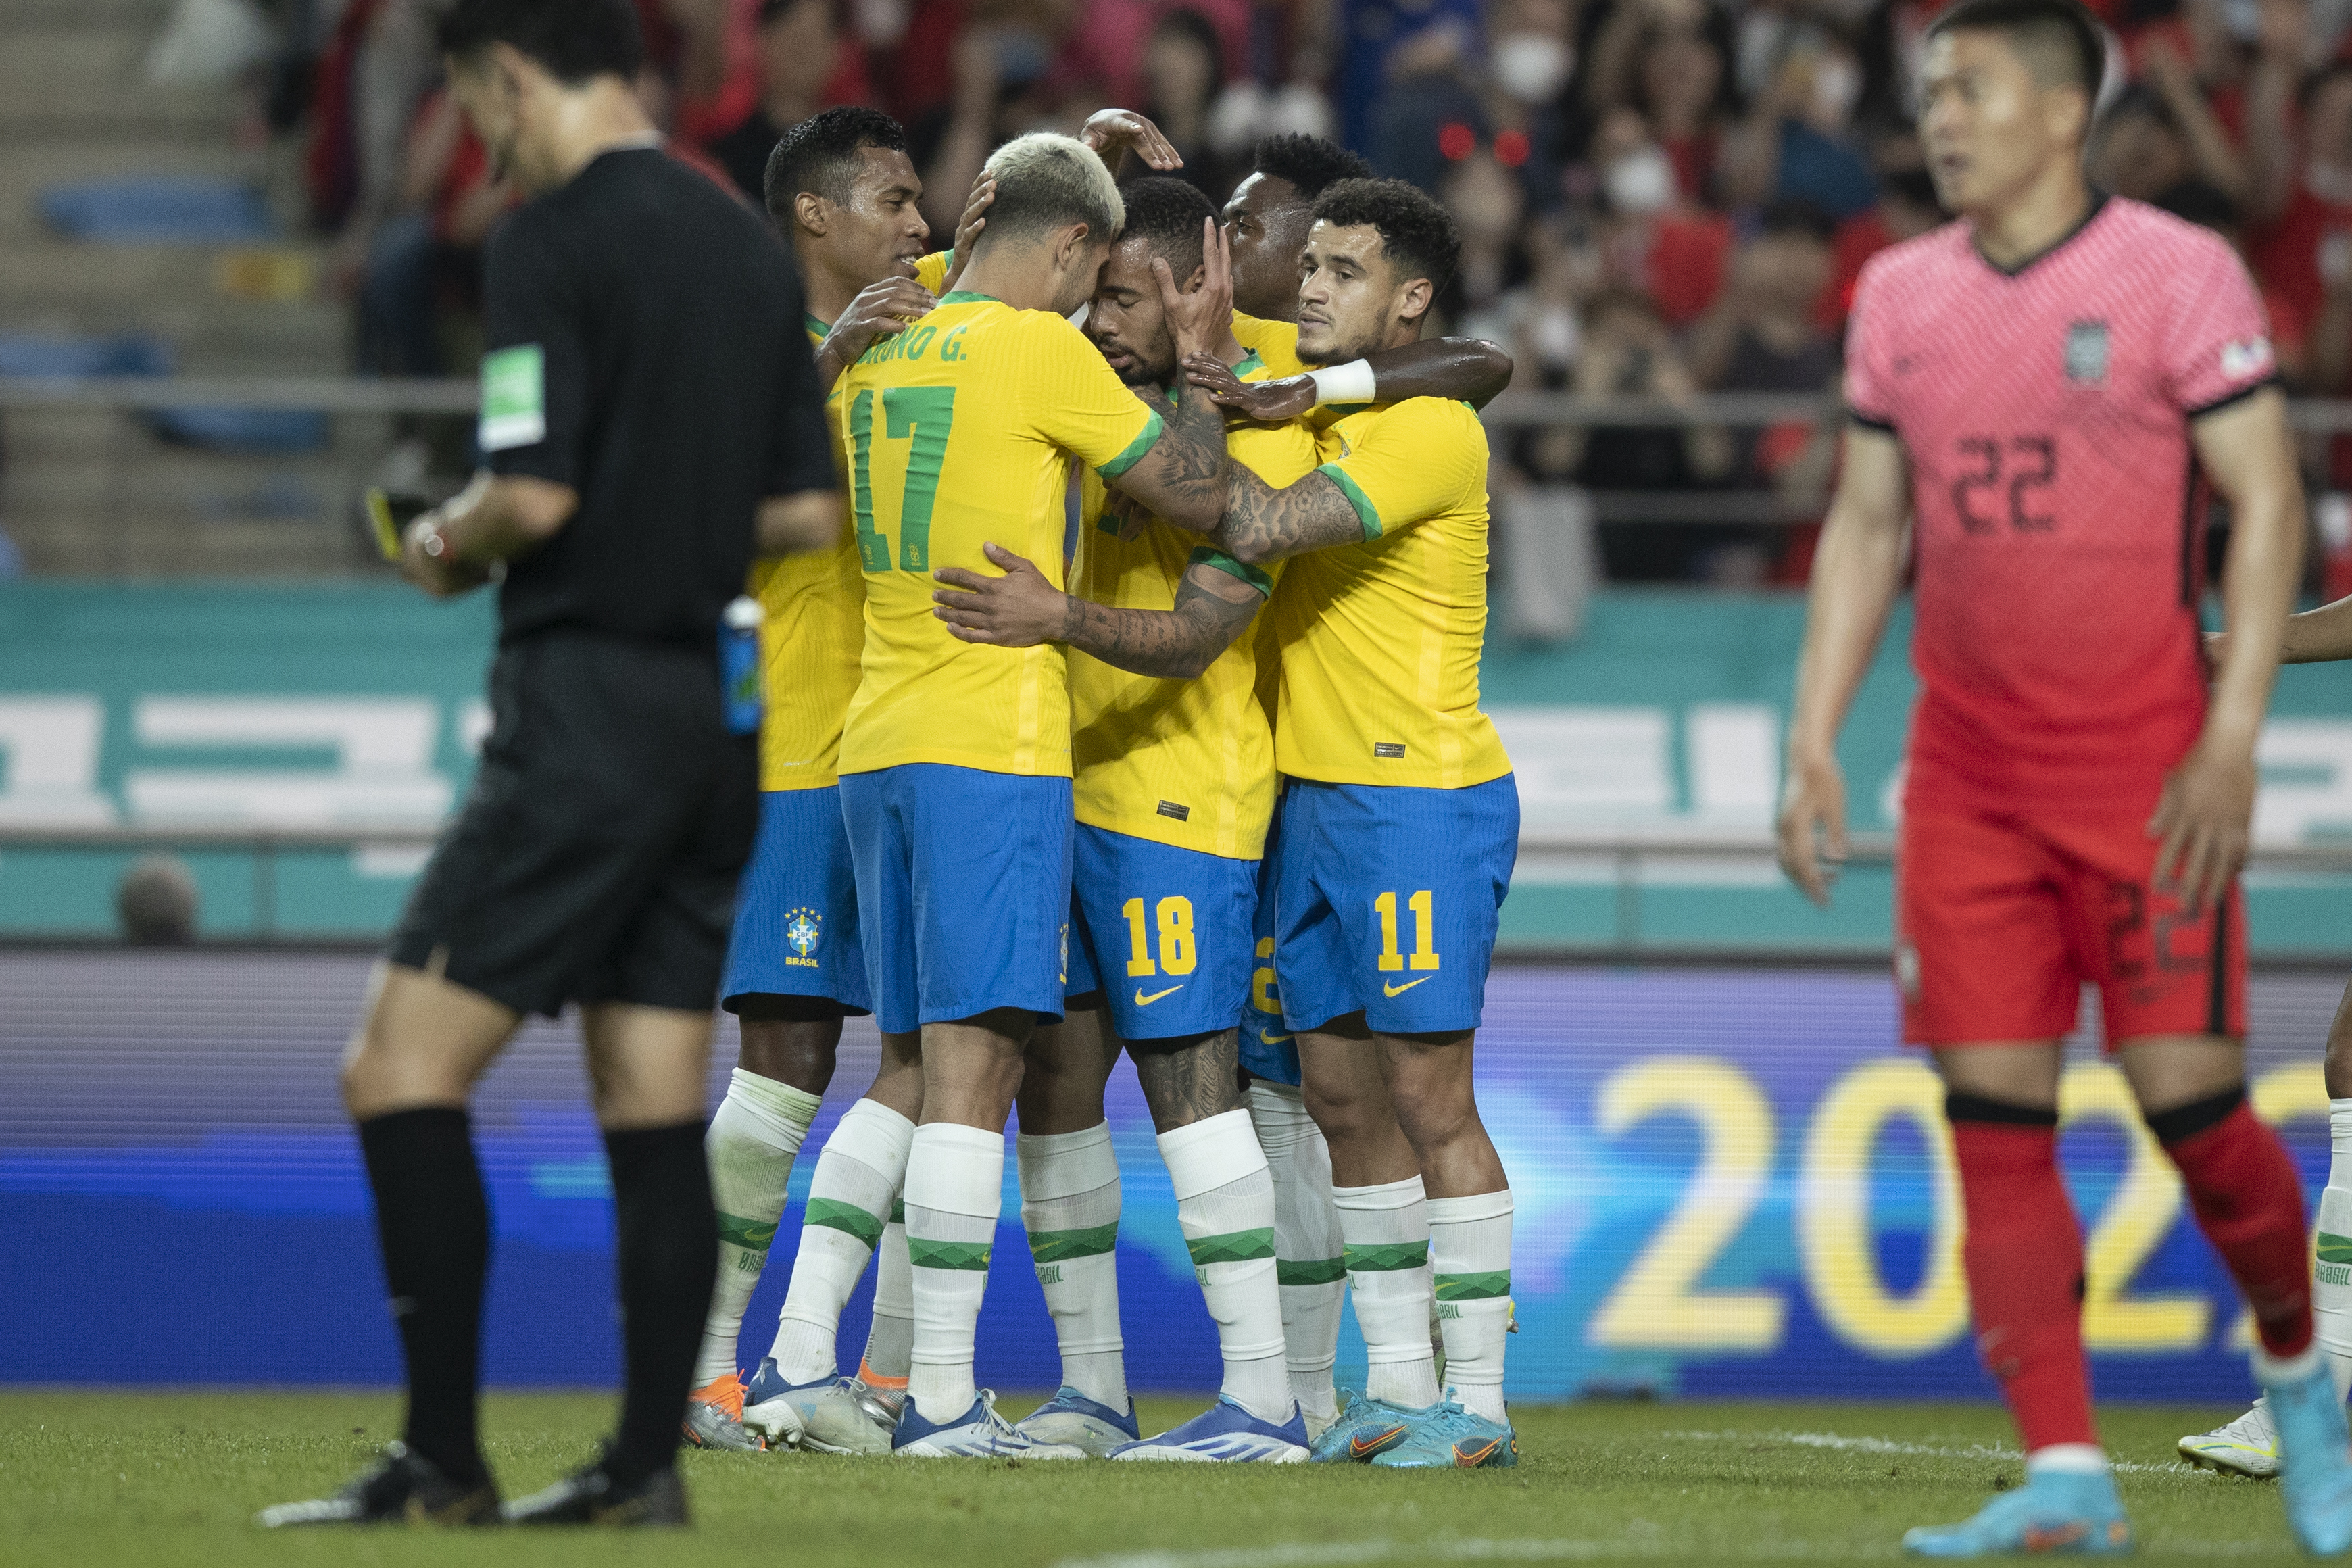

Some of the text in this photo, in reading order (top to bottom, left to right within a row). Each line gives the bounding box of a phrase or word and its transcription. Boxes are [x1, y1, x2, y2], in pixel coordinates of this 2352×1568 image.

[940, 325, 967, 362] G.
[850, 385, 957, 573] 17
[1950, 435, 2057, 535] 22
[785, 956, 819, 968] BRASIL
[1122, 896, 1197, 977] 18
[1375, 890, 1440, 971] 11
[1586, 1054, 2329, 1358] 202
[2315, 1261, 2351, 1285] BRASIL
